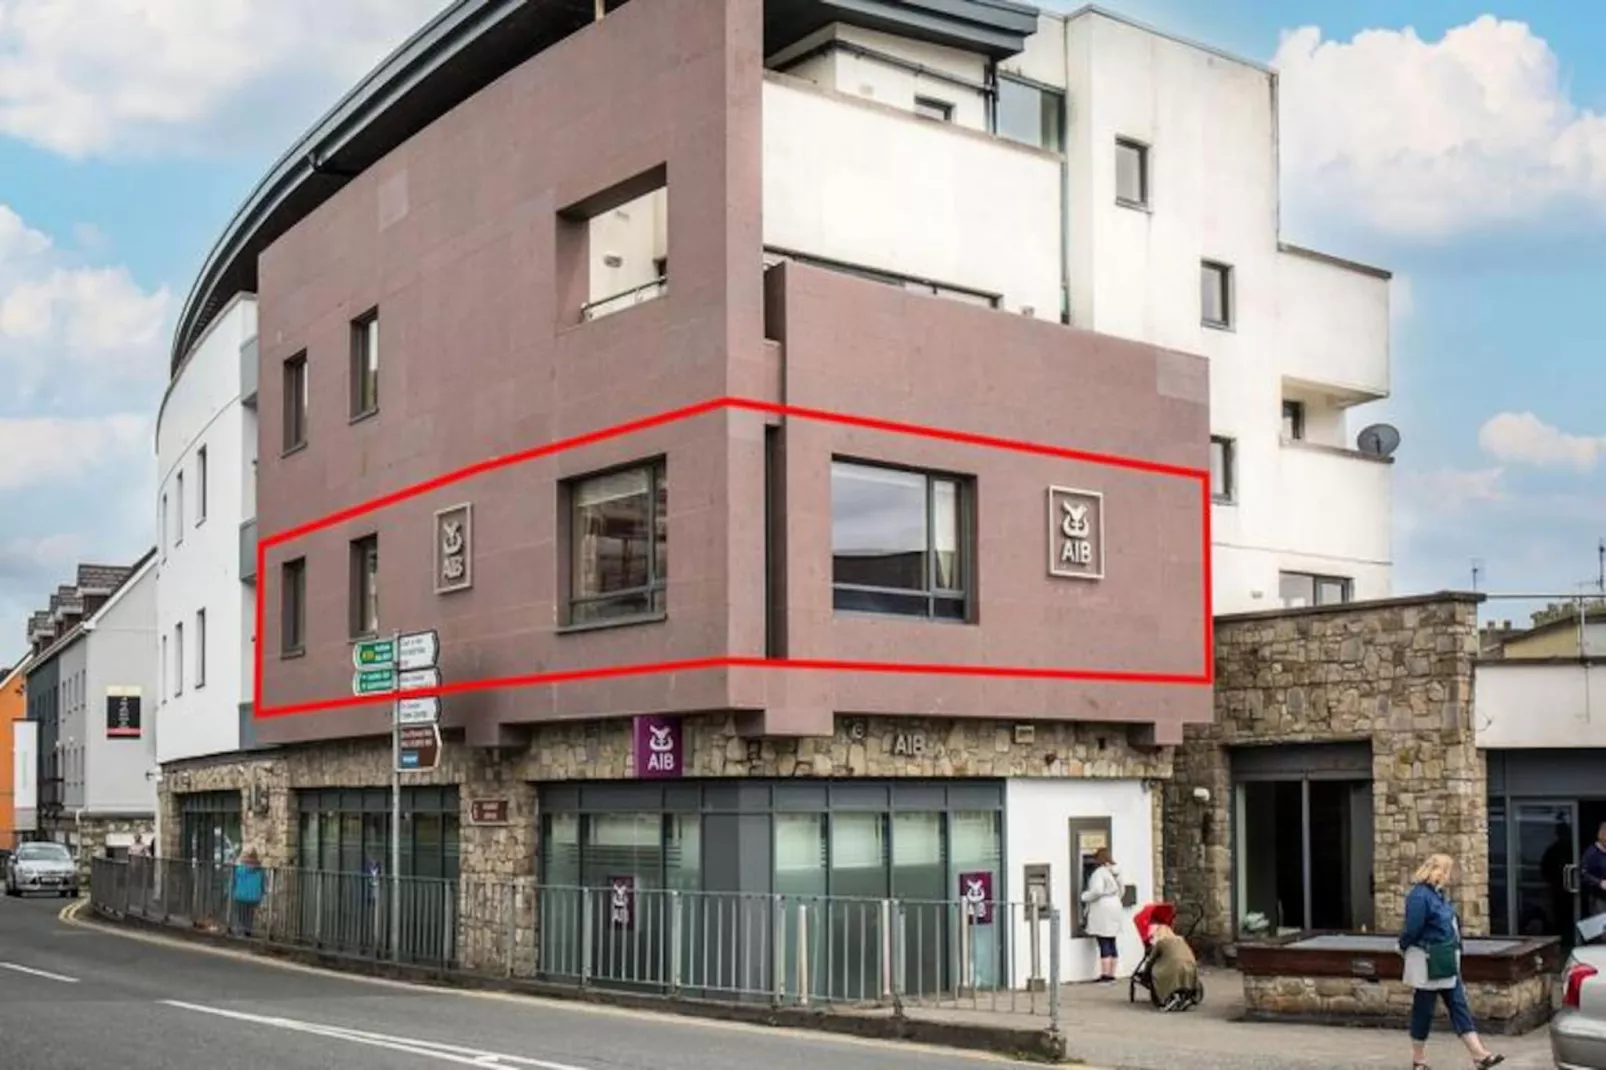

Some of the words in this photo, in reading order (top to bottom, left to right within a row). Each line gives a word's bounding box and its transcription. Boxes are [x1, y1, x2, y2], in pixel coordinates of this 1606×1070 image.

[1061, 539, 1092, 564] AIB
[894, 733, 926, 755] AIB
[647, 752, 675, 771] AIB
